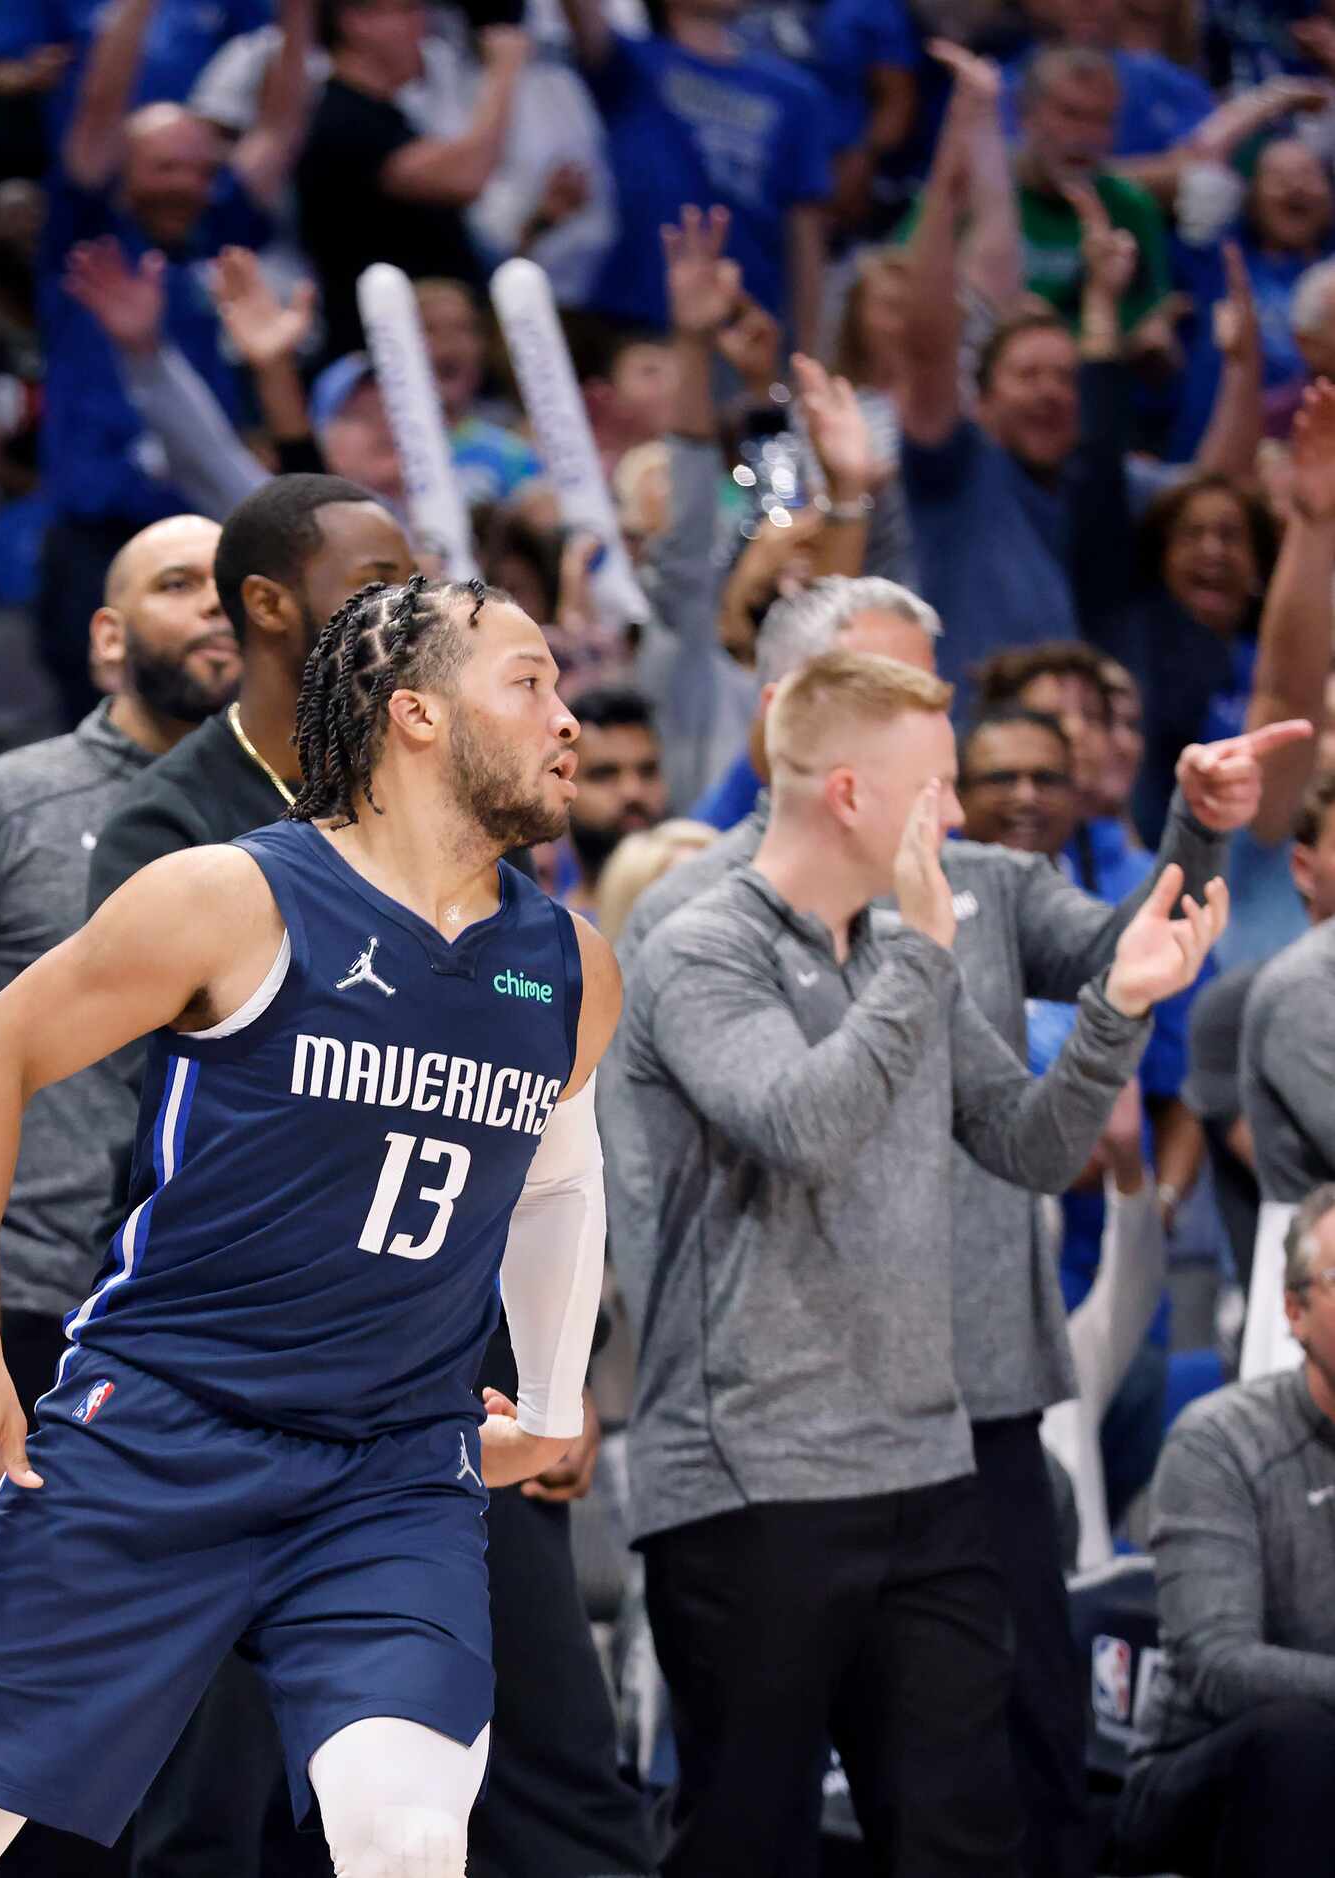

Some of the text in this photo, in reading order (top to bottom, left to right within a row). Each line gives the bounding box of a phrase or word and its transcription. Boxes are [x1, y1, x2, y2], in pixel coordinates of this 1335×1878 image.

[493, 969, 553, 1003] chime
[291, 1034, 562, 1136] MAVERICKS
[357, 1131, 472, 1260] 13
